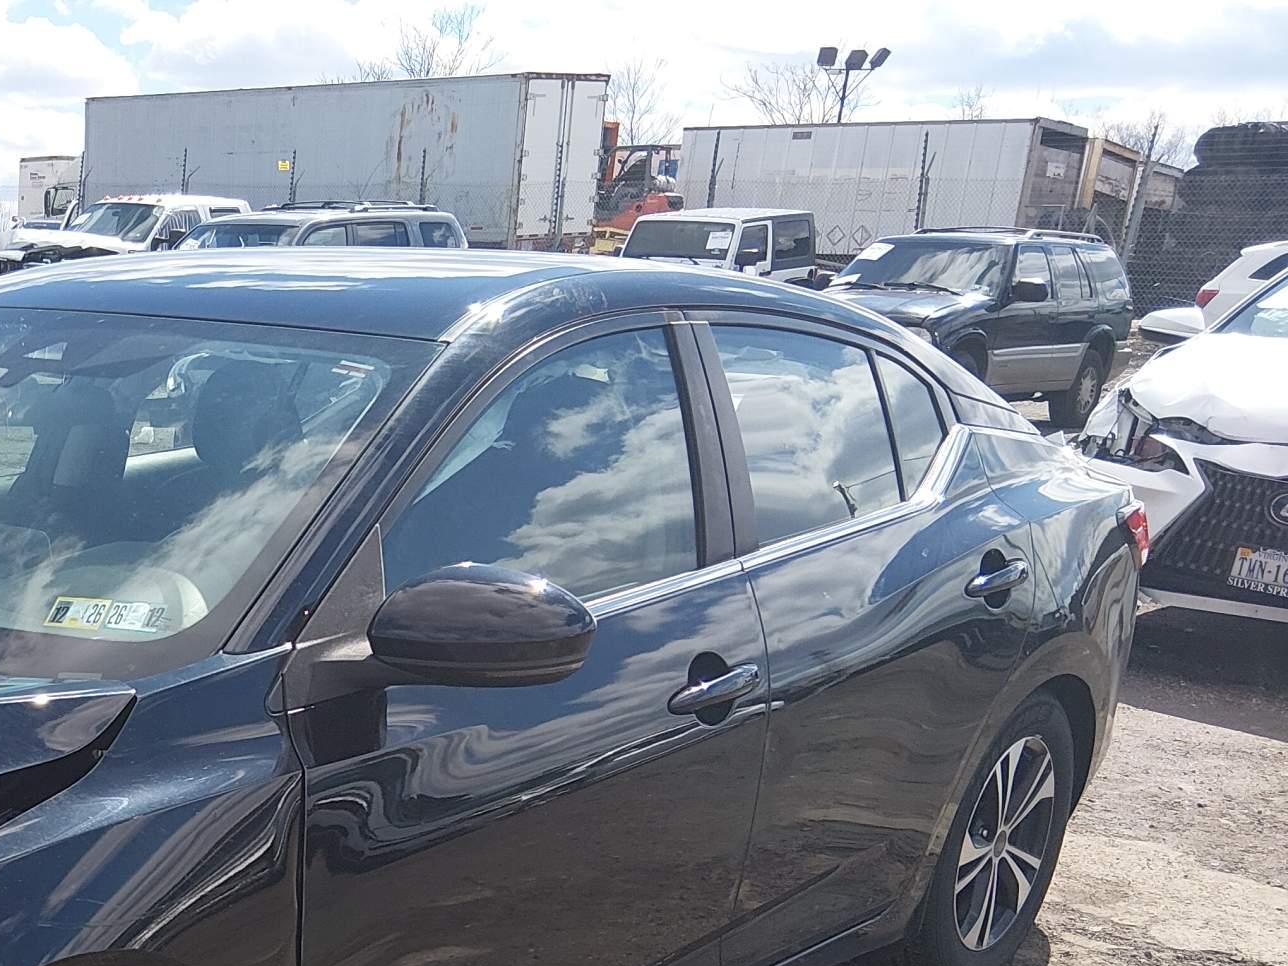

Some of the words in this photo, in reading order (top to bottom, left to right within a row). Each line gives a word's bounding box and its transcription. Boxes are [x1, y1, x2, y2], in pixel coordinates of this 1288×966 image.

[1226, 576, 1265, 592] SILVER
[86, 604, 106, 623] 26
[107, 605, 128, 624] 26
